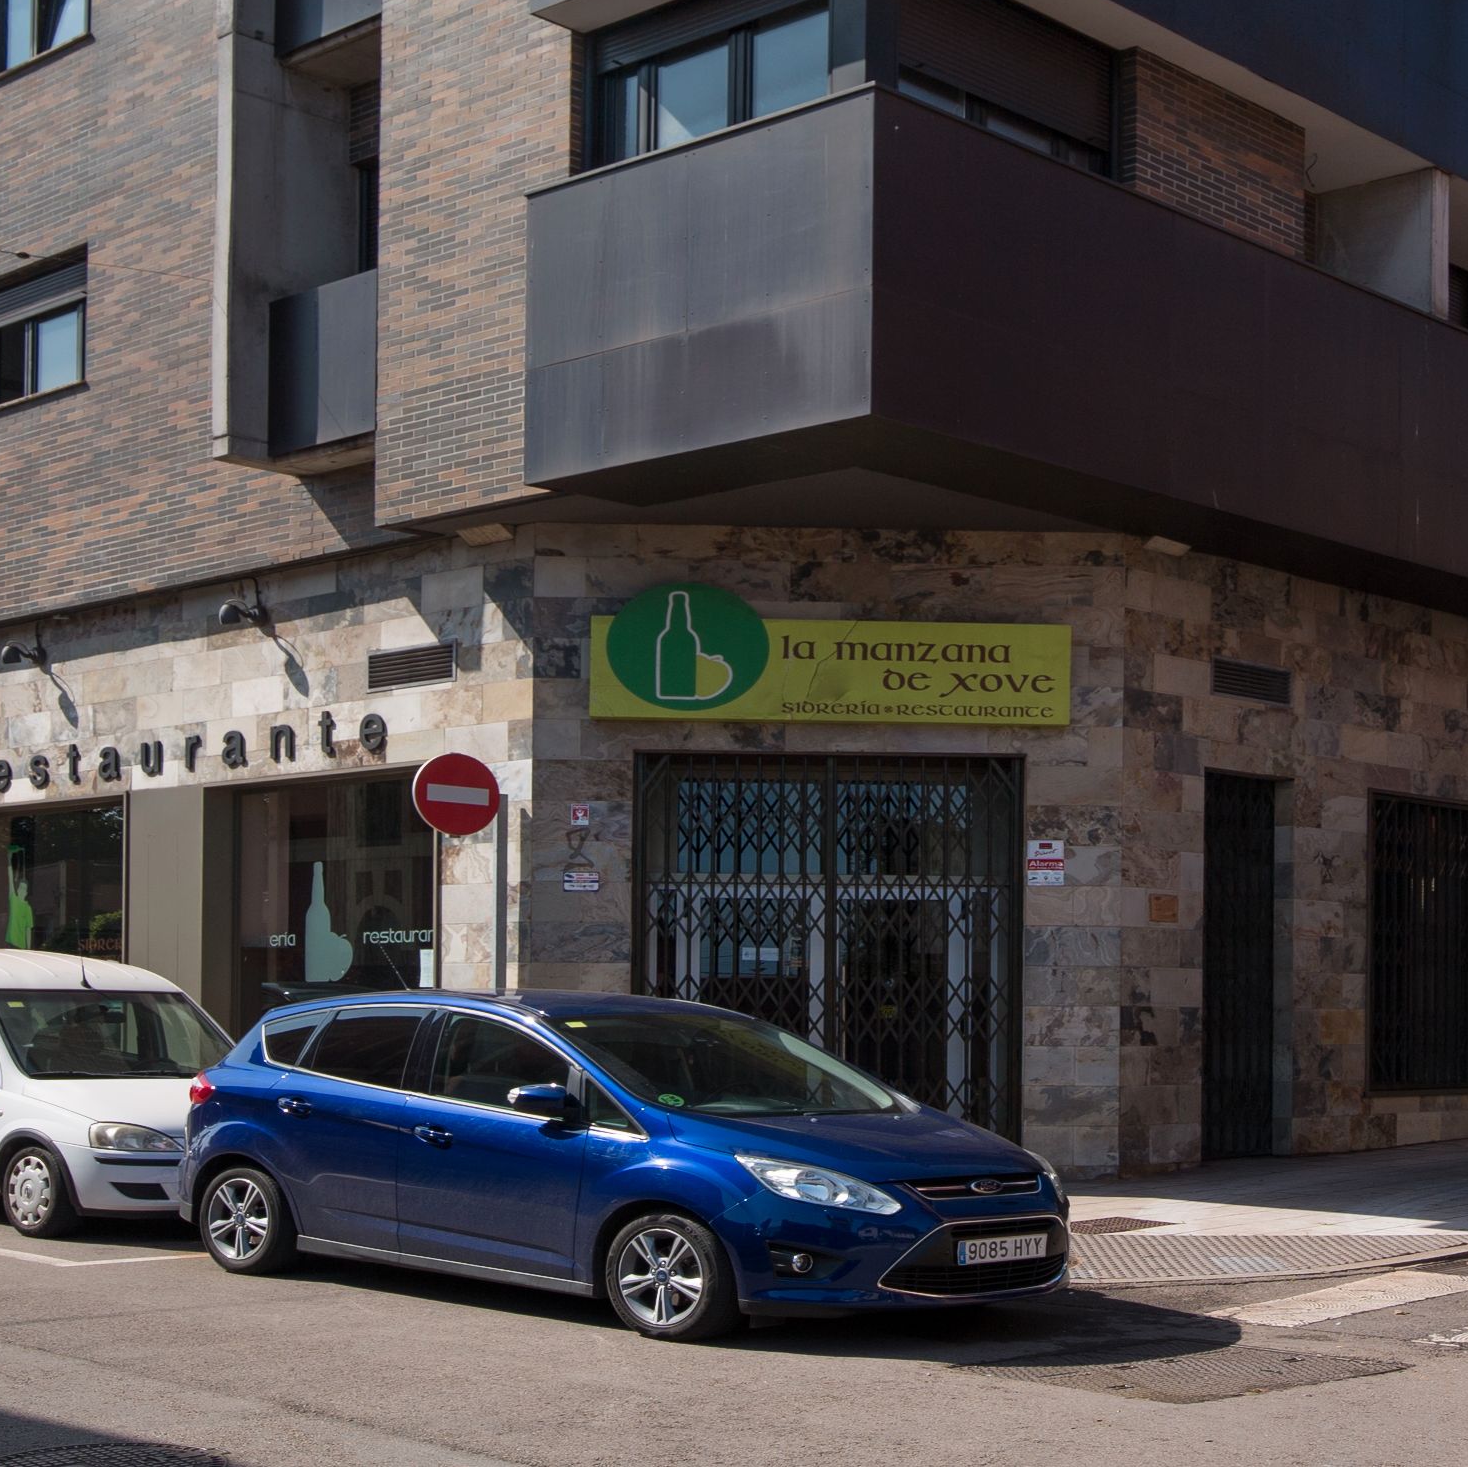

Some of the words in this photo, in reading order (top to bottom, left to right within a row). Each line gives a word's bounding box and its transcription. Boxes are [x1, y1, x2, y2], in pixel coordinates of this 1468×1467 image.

[781, 635, 815, 660] la
[834, 639, 1011, 665] manzana
[883, 668, 933, 691] de
[939, 672, 1055, 698] xove
[968, 1241, 1008, 1260] 9085
[1014, 1237, 1042, 1257] HYY
